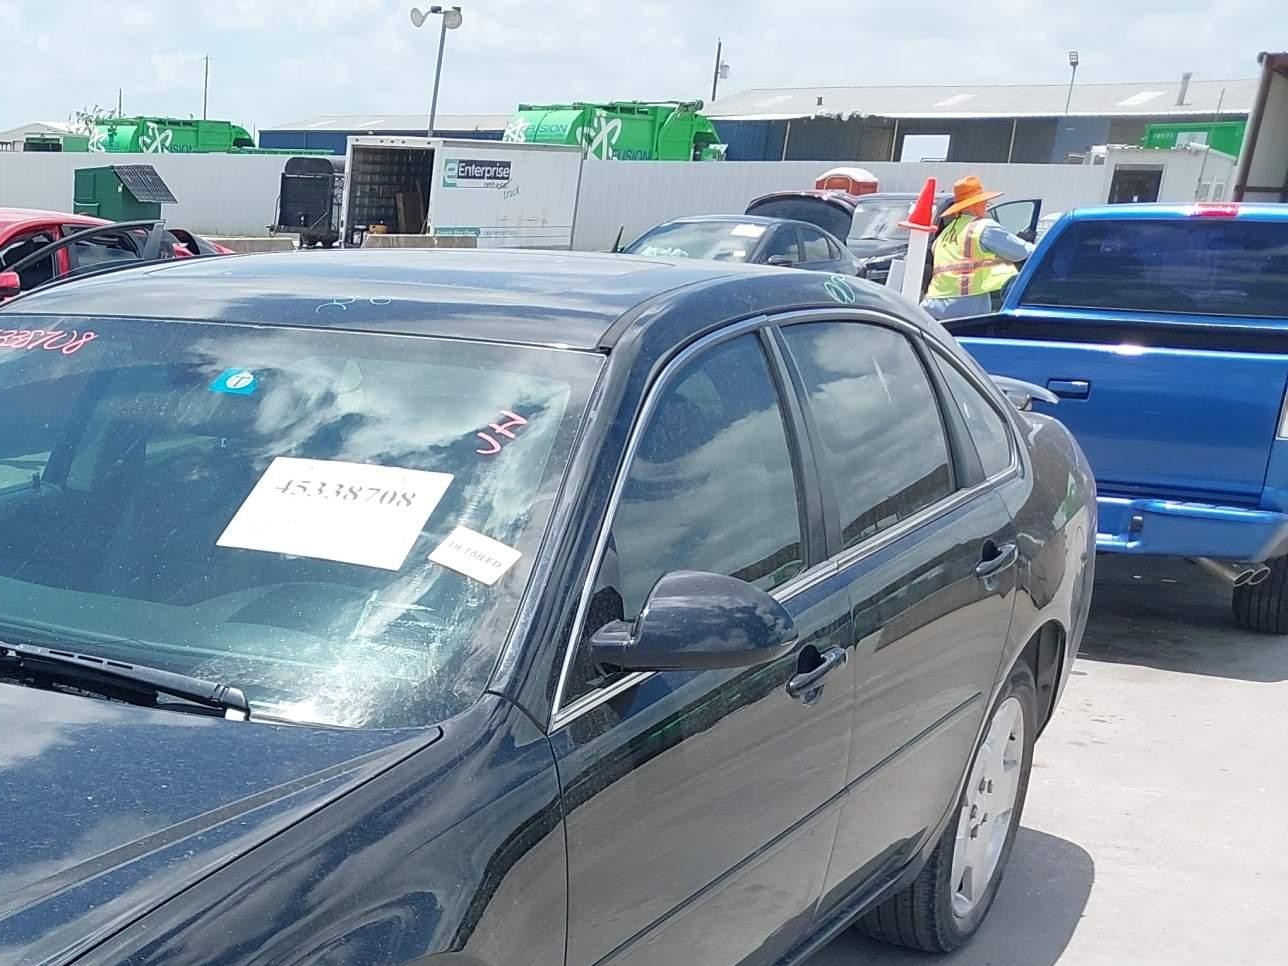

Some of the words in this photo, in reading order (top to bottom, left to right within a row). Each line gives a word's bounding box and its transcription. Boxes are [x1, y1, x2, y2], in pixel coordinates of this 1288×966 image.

[527, 124, 567, 133] FUSION
[458, 163, 510, 178] Enterprise
[274, 479, 416, 507] 45338708
